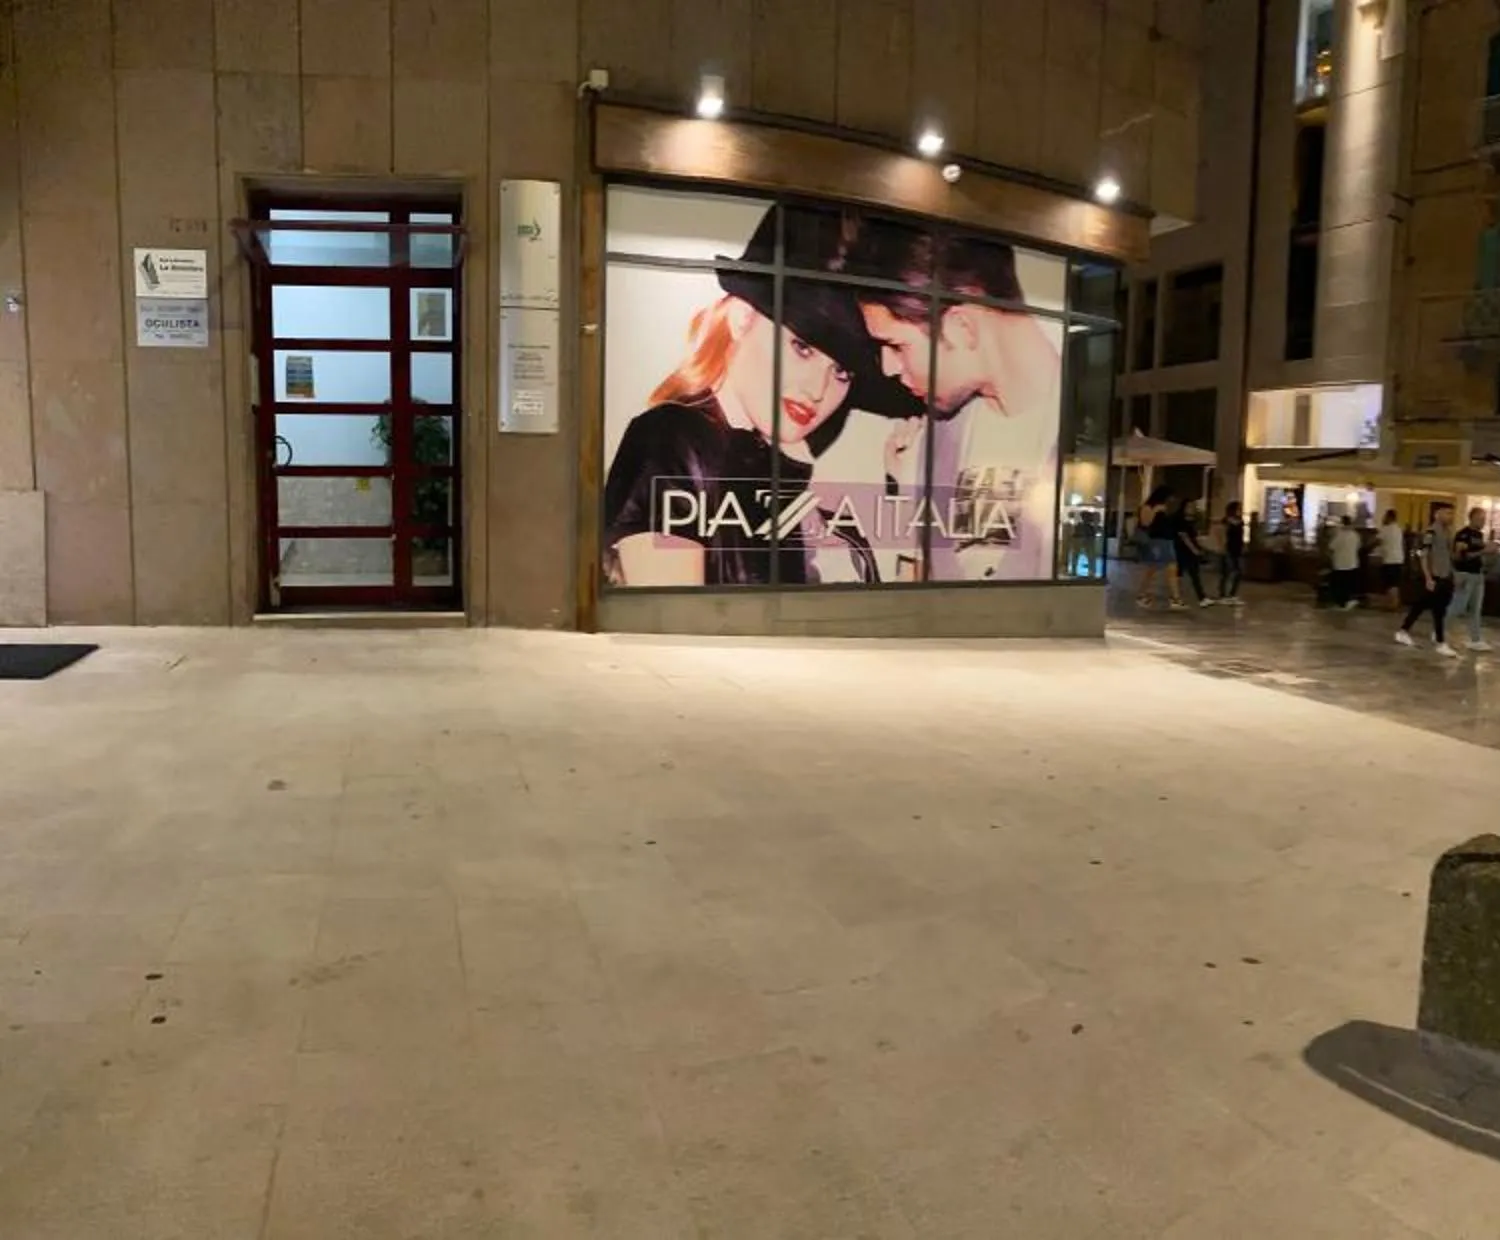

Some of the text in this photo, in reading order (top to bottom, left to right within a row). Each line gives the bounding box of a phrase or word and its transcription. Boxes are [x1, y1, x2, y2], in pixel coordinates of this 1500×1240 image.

[144, 318, 201, 329] OCULISTA
[662, 489, 1016, 541] PIAZZA ITALIA
